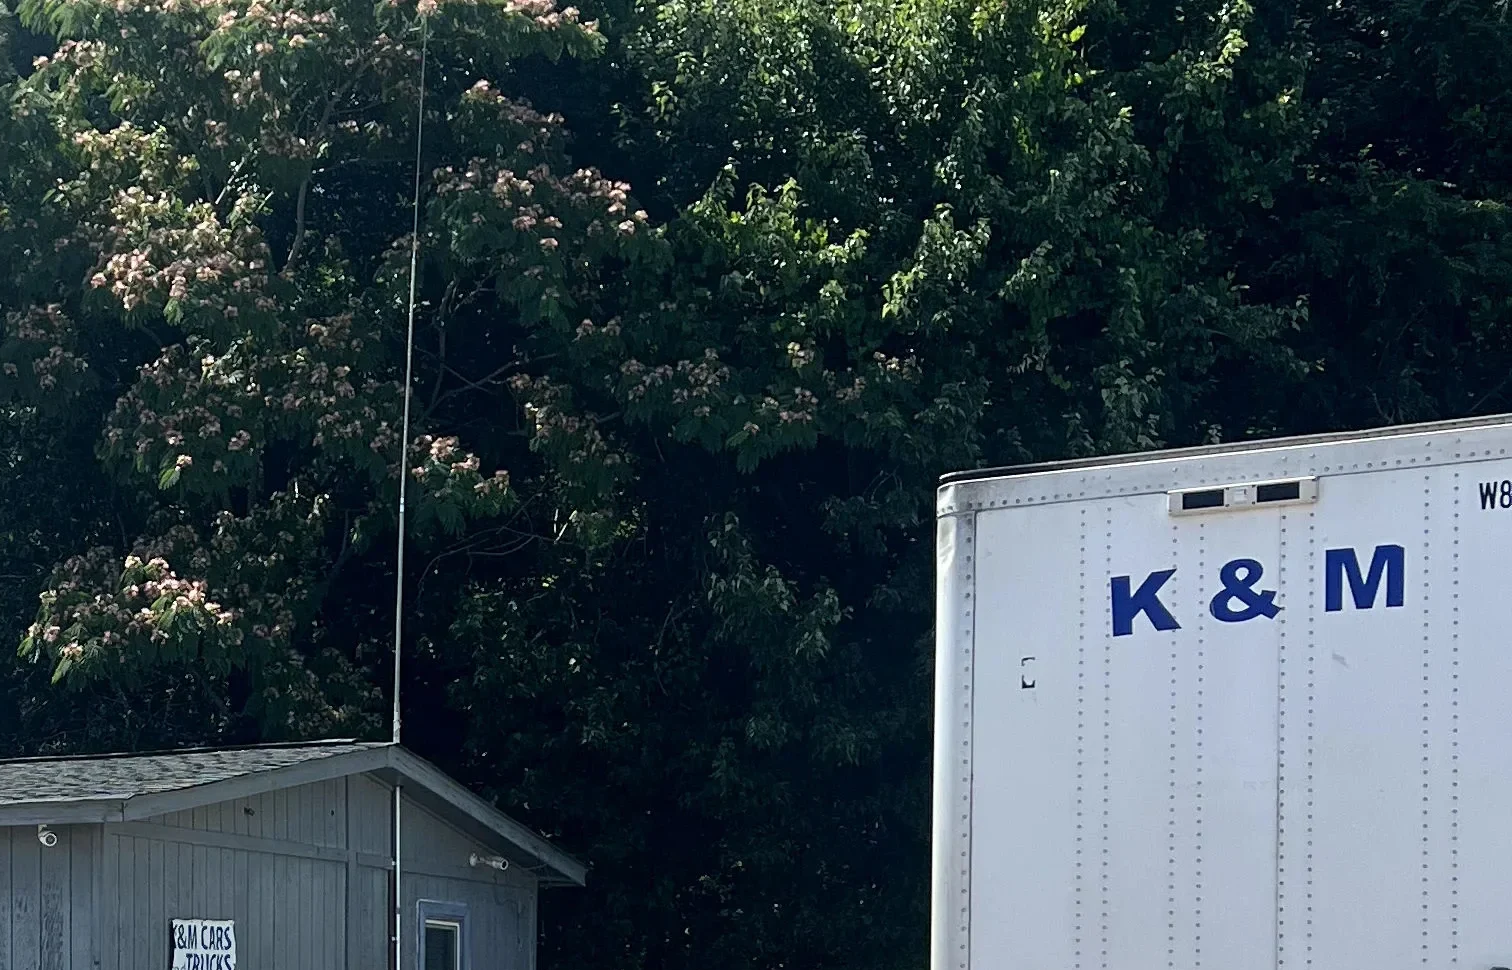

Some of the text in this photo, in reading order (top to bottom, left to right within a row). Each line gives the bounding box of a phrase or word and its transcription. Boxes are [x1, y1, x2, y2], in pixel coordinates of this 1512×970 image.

[1110, 544, 1405, 637] K & M
[201, 925, 232, 951] CARS
